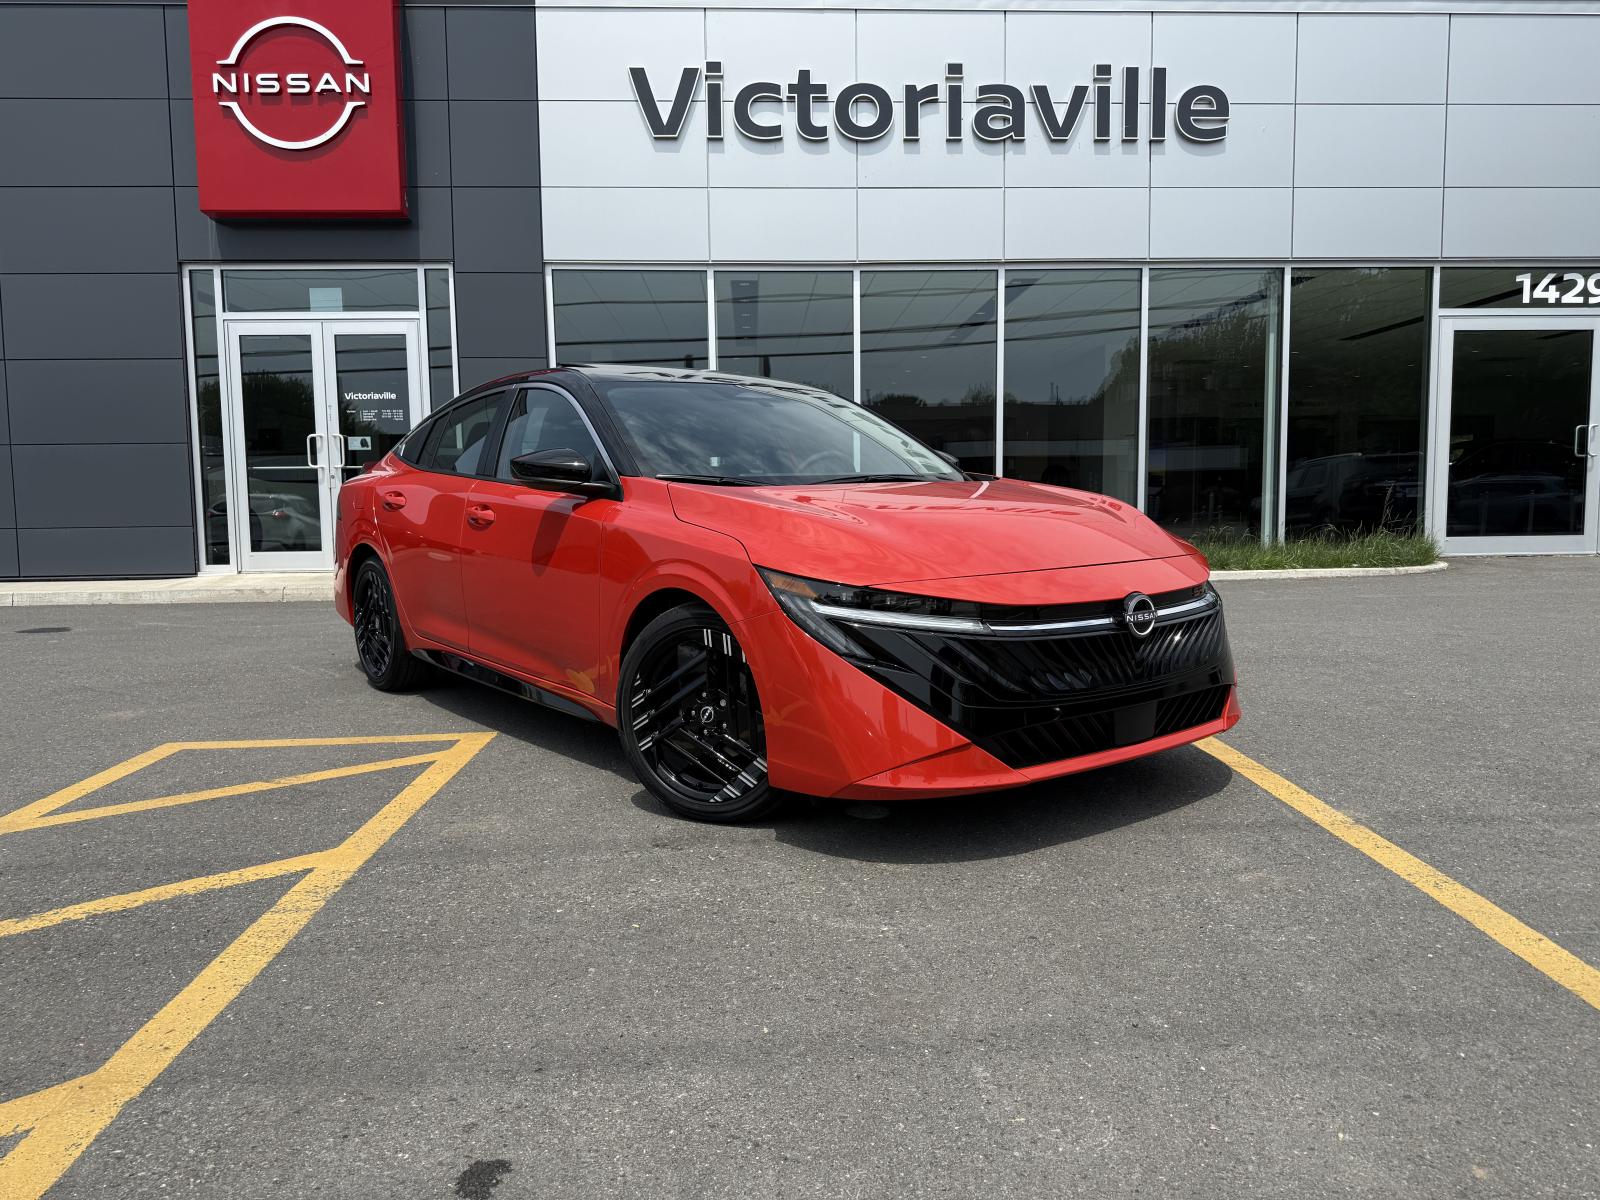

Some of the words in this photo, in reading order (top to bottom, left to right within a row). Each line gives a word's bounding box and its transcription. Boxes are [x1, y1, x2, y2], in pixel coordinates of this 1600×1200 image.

[212, 72, 370, 93] NISSAN
[628, 61, 1231, 142] Victoriaville
[344, 391, 397, 400] Victoriaville
[1126, 610, 1158, 622] NISSAN
